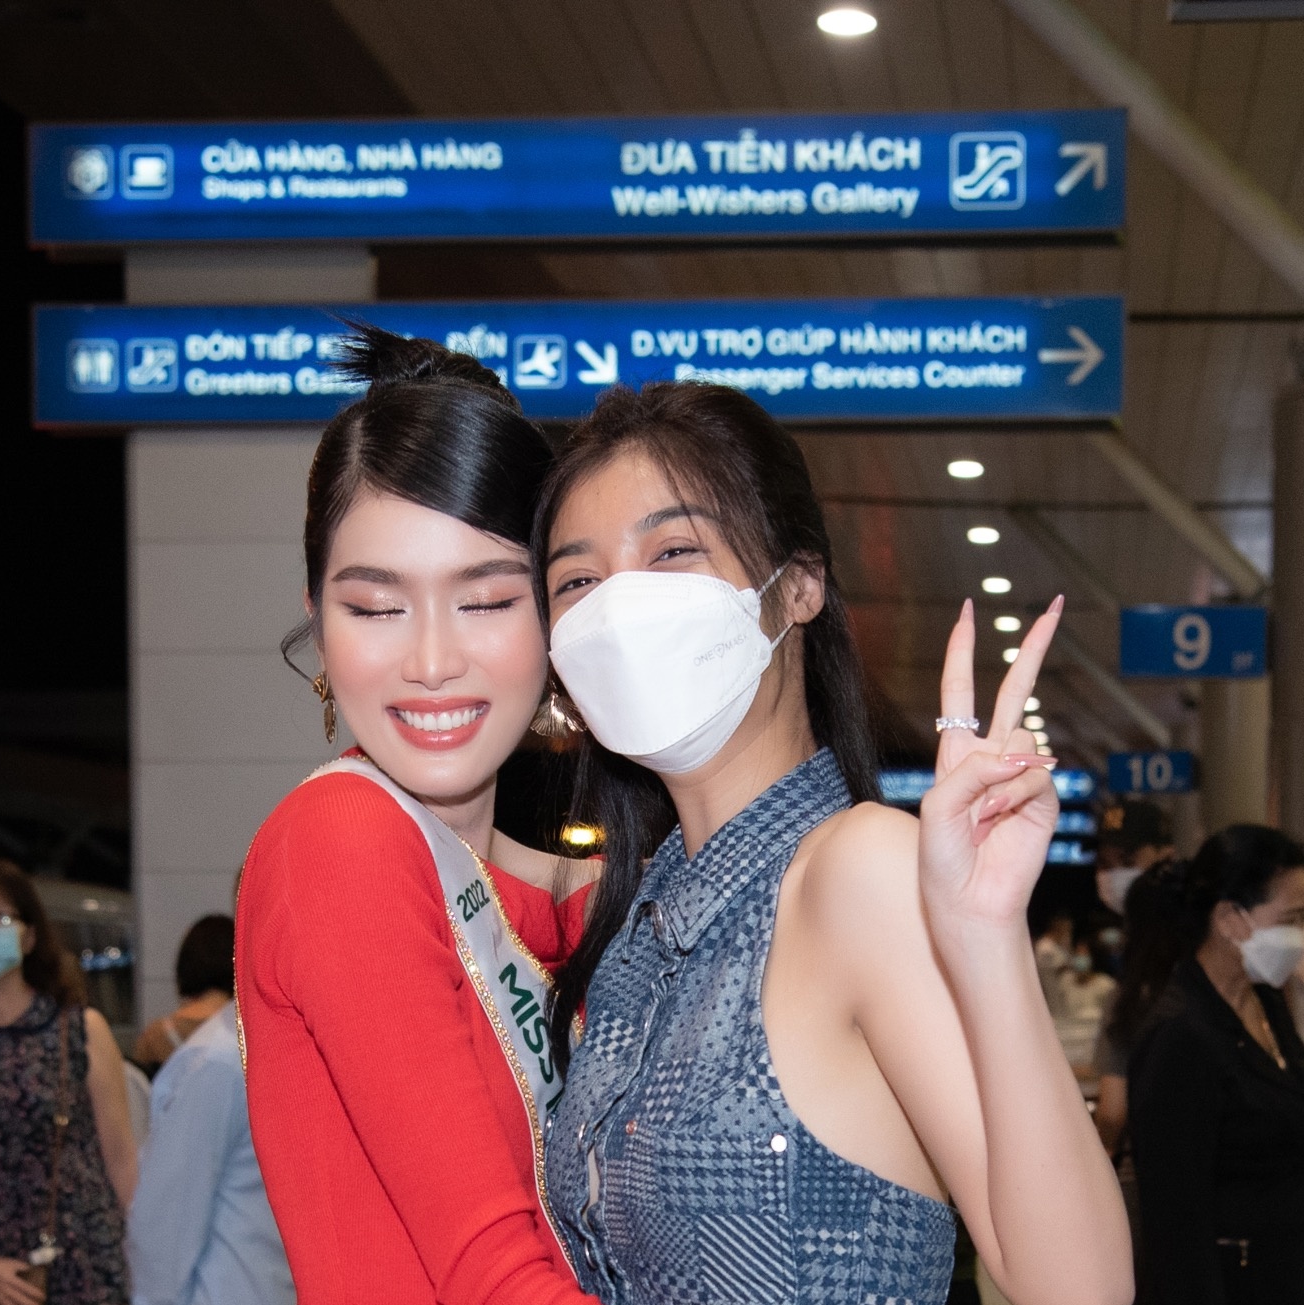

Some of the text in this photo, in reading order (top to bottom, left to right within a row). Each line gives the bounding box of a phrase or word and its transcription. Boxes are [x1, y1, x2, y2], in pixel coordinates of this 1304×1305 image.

[356, 138, 418, 171] NHÀ
[420, 137, 503, 170] HÀNG
[793, 131, 922, 172] KHÁCH
[201, 174, 408, 202] Shops & Restaurants
[610, 181, 920, 218] Well-Wishers Gallery
[765, 323, 837, 356] GIÚP
[839, 322, 923, 354] HÀNH
[925, 321, 1027, 354] KHÁCH
[810, 361, 921, 390] Services
[922, 359, 1027, 388] Counter
[1173, 612, 1212, 670] 9
[1128, 755, 1173, 790] 10
[456, 879, 490, 922] 2022
